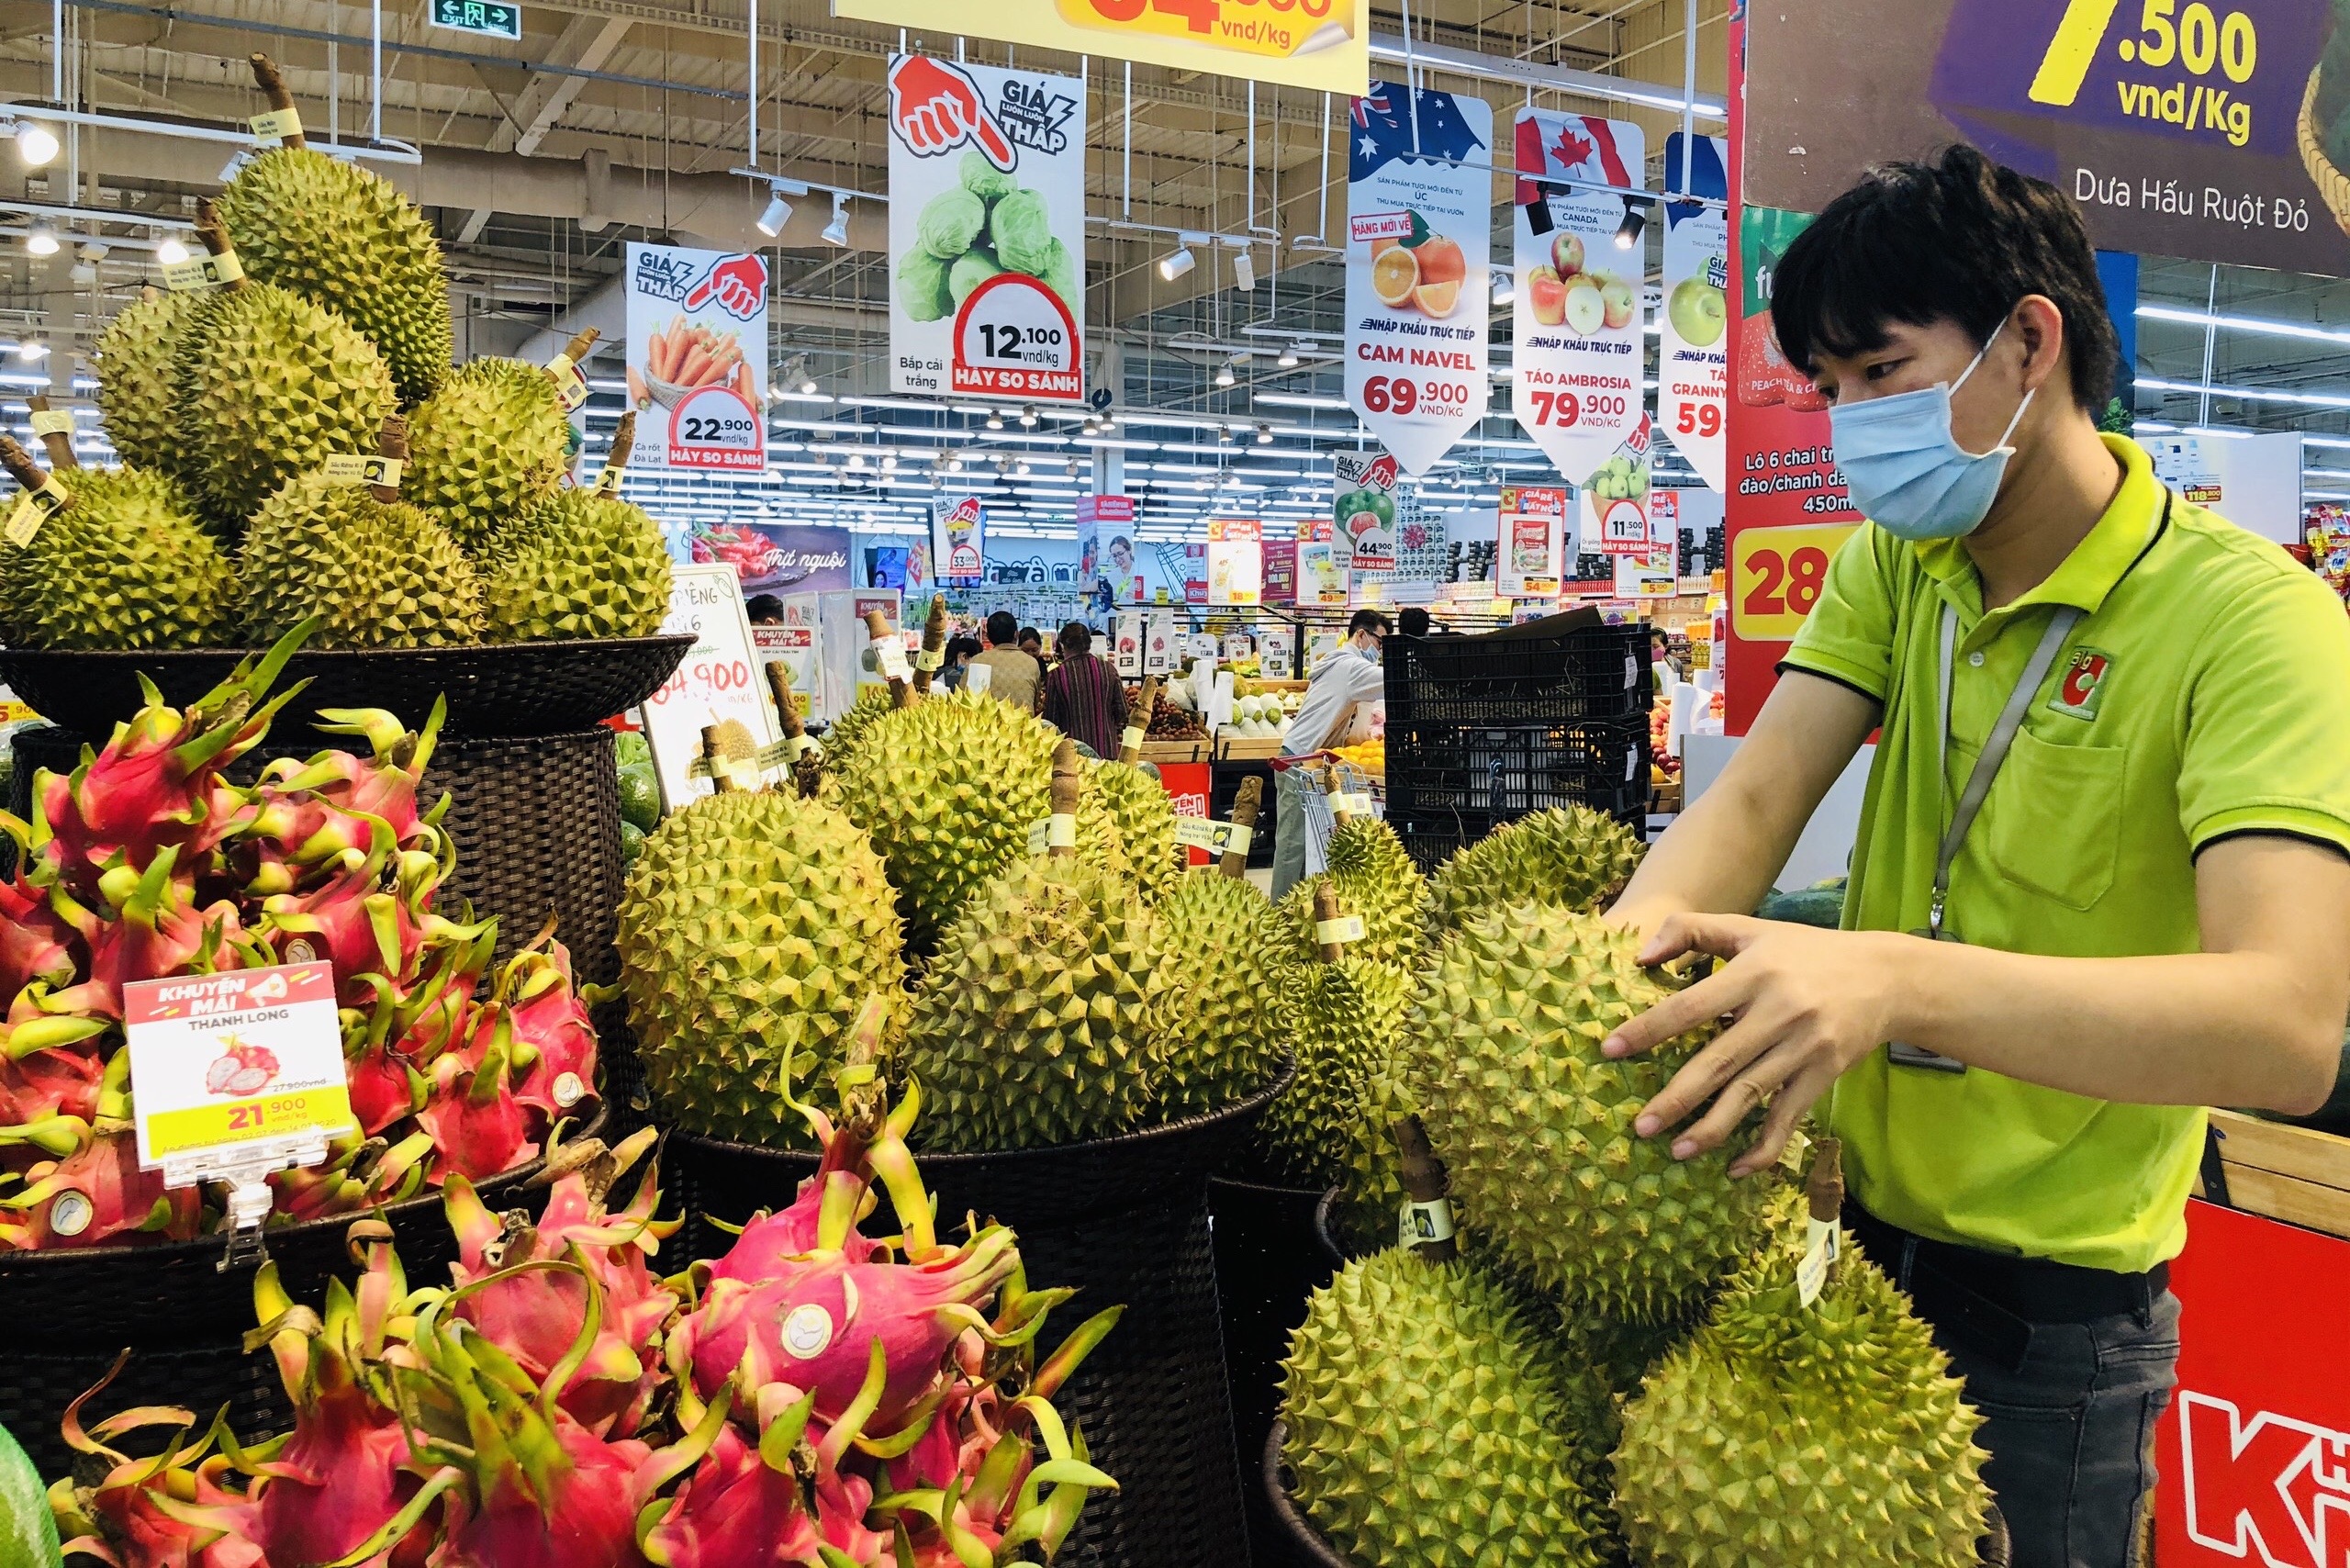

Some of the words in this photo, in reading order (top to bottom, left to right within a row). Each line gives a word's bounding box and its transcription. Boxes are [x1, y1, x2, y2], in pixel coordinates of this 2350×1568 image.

[442, 14, 464, 24] EXIT
[1221, 20, 1291, 50] vnd/kg
[1002, 80, 1048, 113] GIÁ
[1002, 102, 1024, 117] LUÔN
[1024, 106, 1046, 123] LUÔN
[2117, 81, 2251, 147] vnd/Kg
[1002, 118, 1067, 153] THẤP
[1391, 199, 1404, 207] MUA
[1415, 190, 1427, 201] ÚC
[2076, 168, 2130, 207] Dưa
[2142, 176, 2193, 218] Hấu
[2203, 188, 2265, 230] Ruột
[2274, 195, 2309, 232] Đỏ
[1353, 221, 1378, 235] HÀNG
[1381, 218, 1396, 233] MỚI
[1399, 214, 1412, 231] VỀ
[1562, 213, 1598, 224] CANADA
[639, 252, 672, 274] GIÁ
[1369, 319, 1398, 335] NHẬP
[1400, 319, 1427, 336] KHẨU
[1430, 325, 1453, 341] TRỰC
[1456, 324, 1475, 341] TIẾP
[1534, 336, 1561, 352] NHẬP
[1563, 334, 1588, 352] KHẨU
[1590, 341, 1612, 355] TRỰC
[1614, 340, 1632, 355] TIẾP
[900, 356, 923, 371] Bắp
[925, 358, 944, 371] cải
[1022, 349, 1058, 367] vnd/kg
[1358, 343, 1404, 364] CAM
[1410, 349, 1476, 371] NAVEL
[1681, 349, 1707, 364] NHẬP
[905, 375, 937, 389] trắng
[956, 368, 993, 387] HÃY
[998, 370, 1024, 389] SO
[1029, 370, 1079, 392] SÁNH
[1525, 368, 1554, 385] TÁO
[1558, 373, 1632, 390] AMBROSIA
[1751, 377, 1784, 391] PEACH
[1784, 378, 1795, 394] TEA
[1419, 404, 1463, 417] VND/KG
[1581, 417, 1621, 428] VND/KG
[635, 442, 646, 452] Cà
[647, 442, 661, 452] rốt
[721, 433, 749, 446] vnd/kg
[634, 454, 646, 464] Đà
[648, 454, 662, 465] Lạt
[670, 448, 700, 463] HÃY
[702, 451, 724, 465] SO
[726, 451, 762, 465] SÁNH
[1337, 456, 1353, 466] GIÁ
[1745, 450, 1765, 471] Lô
[1769, 452, 1780, 468] 6
[1783, 447, 1817, 467] chai
[1740, 471, 1823, 495] đào/chanh
[1526, 489, 1540, 498] GIÁ
[1540, 491, 1553, 501] RẺ
[1602, 541, 1618, 551] HÃY
[1618, 543, 1628, 551] SO
[1629, 542, 1649, 552] SÁNH
[766, 548, 796, 568] Thịt
[799, 550, 846, 571] nguội
[1352, 557, 1367, 568] HÃY
[1367, 559, 1375, 568] SO
[1376, 558, 1393, 569] SÁNH
[757, 629, 795, 639] KHUYẾN
[158, 979, 246, 1002] KHUYẾN
[190, 996, 237, 1016] MÃI
[188, 1014, 243, 1031] THANH
[248, 1009, 289, 1024] LONG
[271, 1111, 308, 1124] vnd/kg
